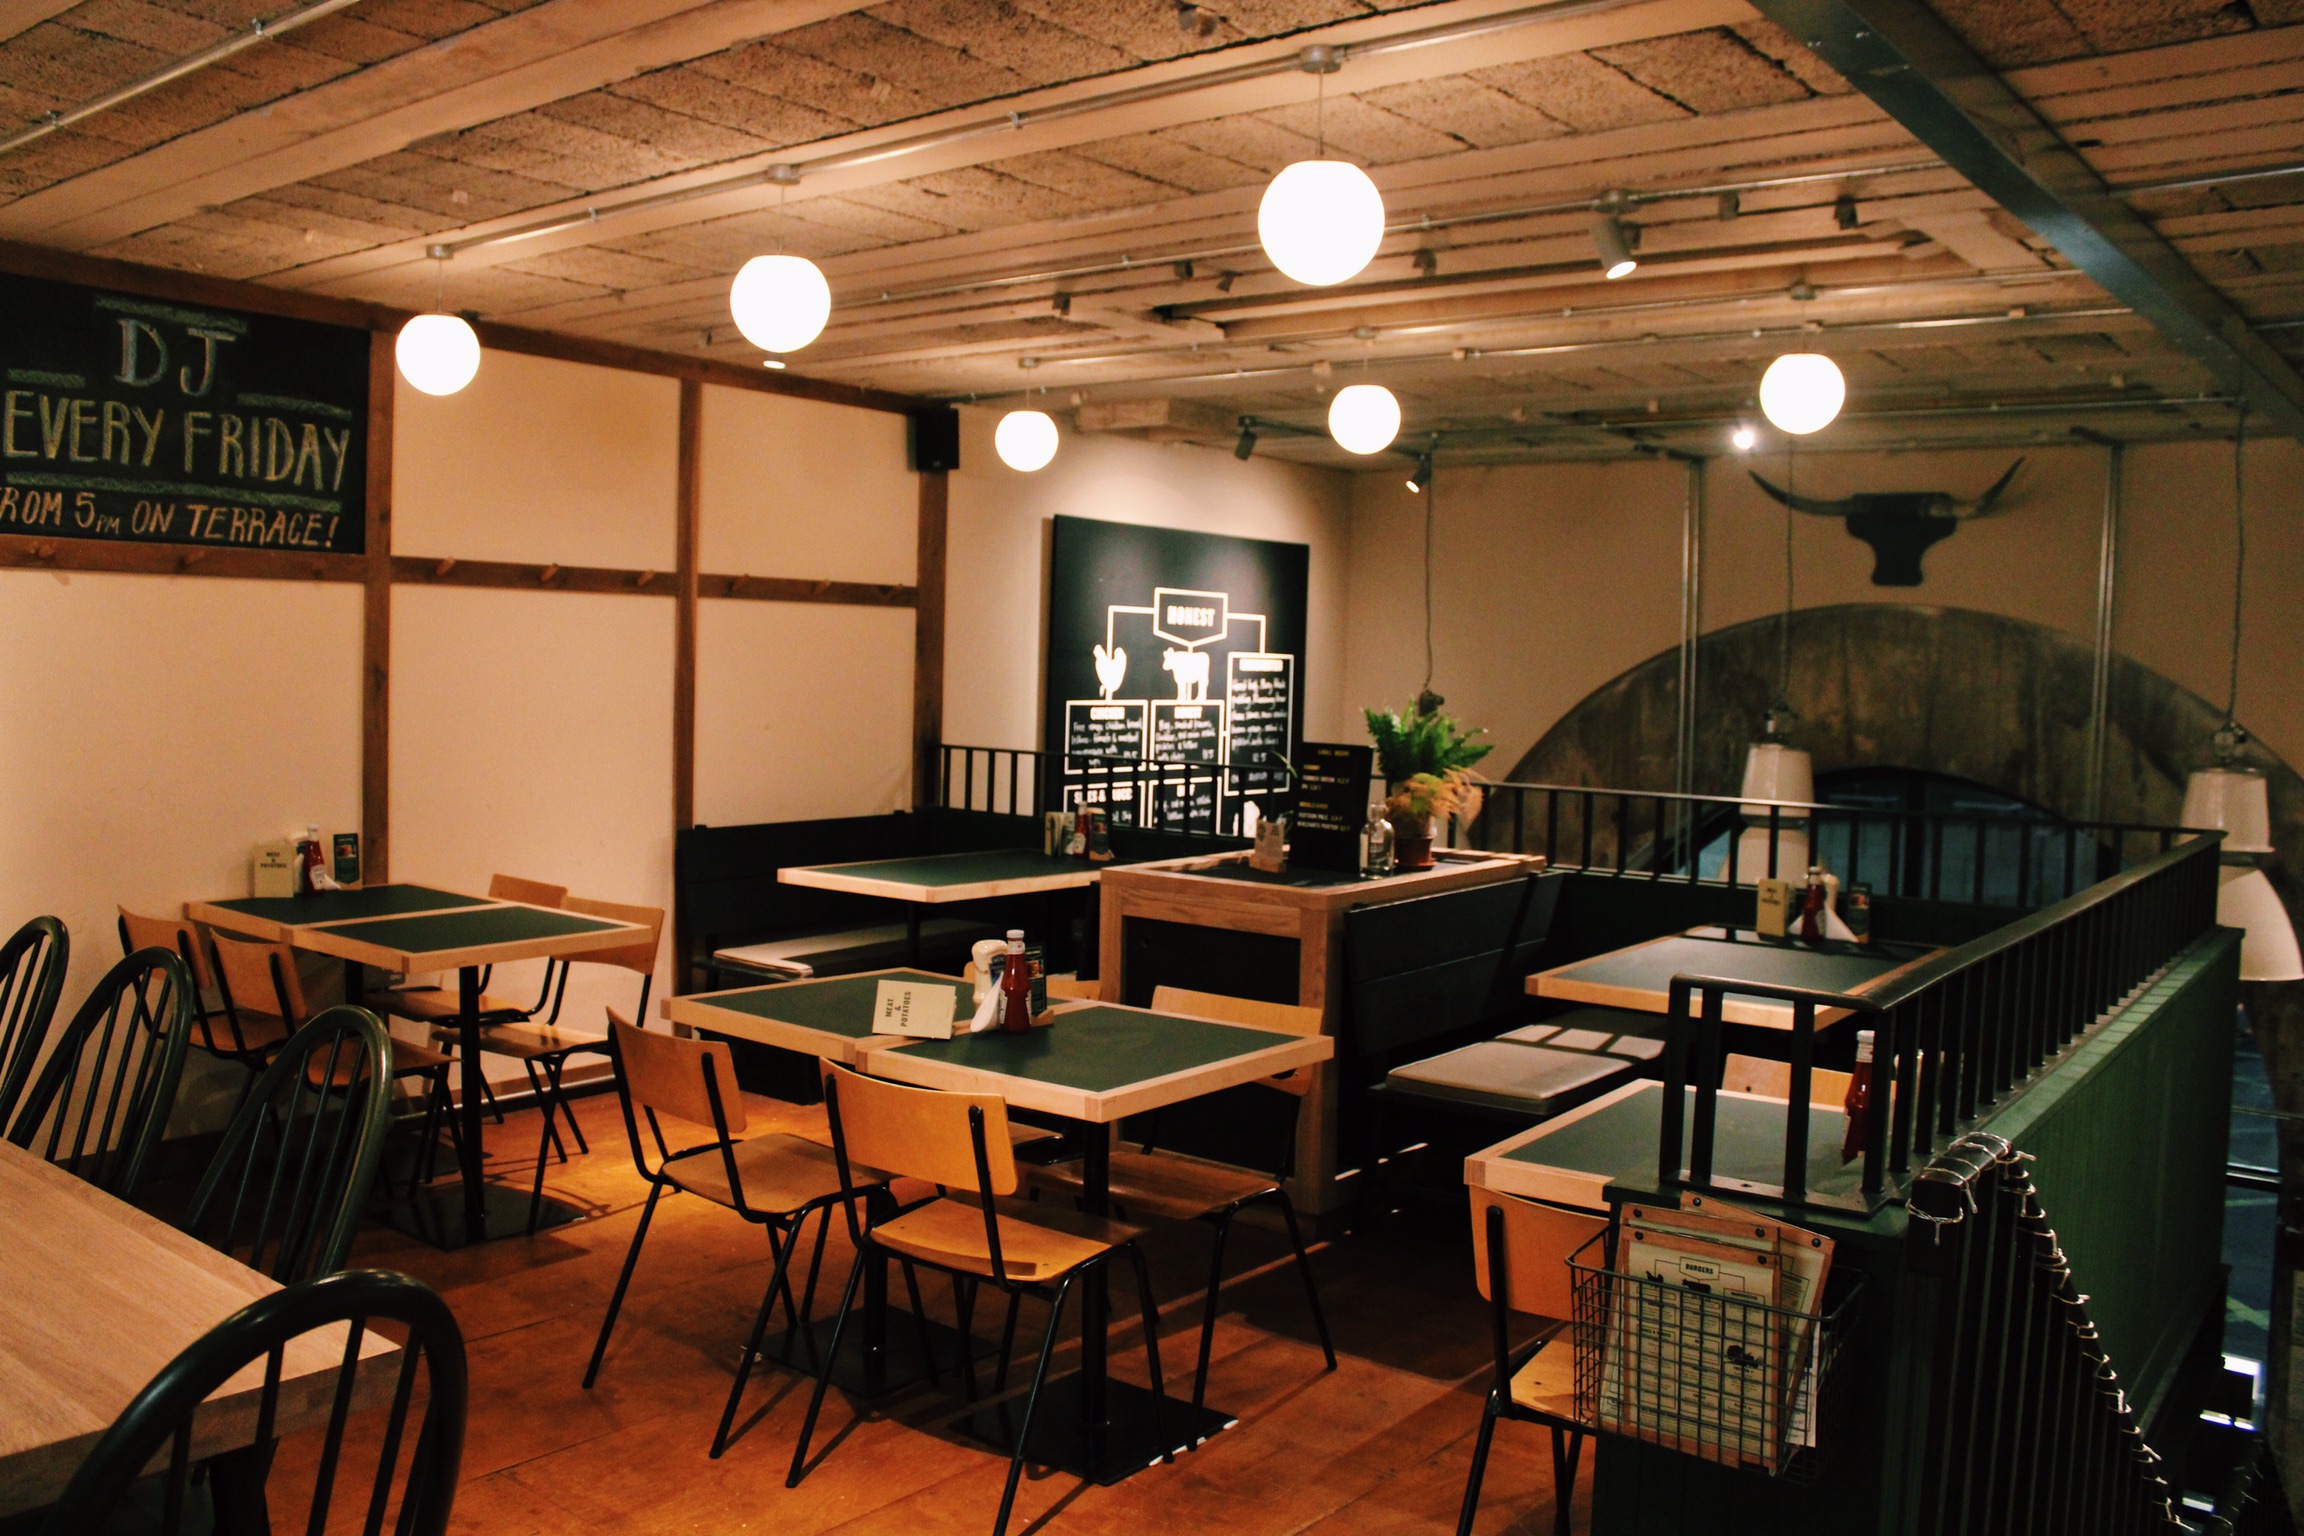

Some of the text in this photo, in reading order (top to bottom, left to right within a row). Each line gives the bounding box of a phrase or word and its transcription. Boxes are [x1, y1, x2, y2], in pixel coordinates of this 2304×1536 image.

[114, 318, 236, 396] DJ
[3, 390, 350, 492] EVERY FRIDAY
[0, 486, 62, 526] ROM
[131, 501, 175, 535] ON
[187, 503, 339, 548] TERRACE!
[1167, 605, 1216, 627] HONEST
[885, 998, 894, 1017] MEAT
[901, 991, 911, 1027] POTATOES
[1685, 1263, 1714, 1275] BURGERS
